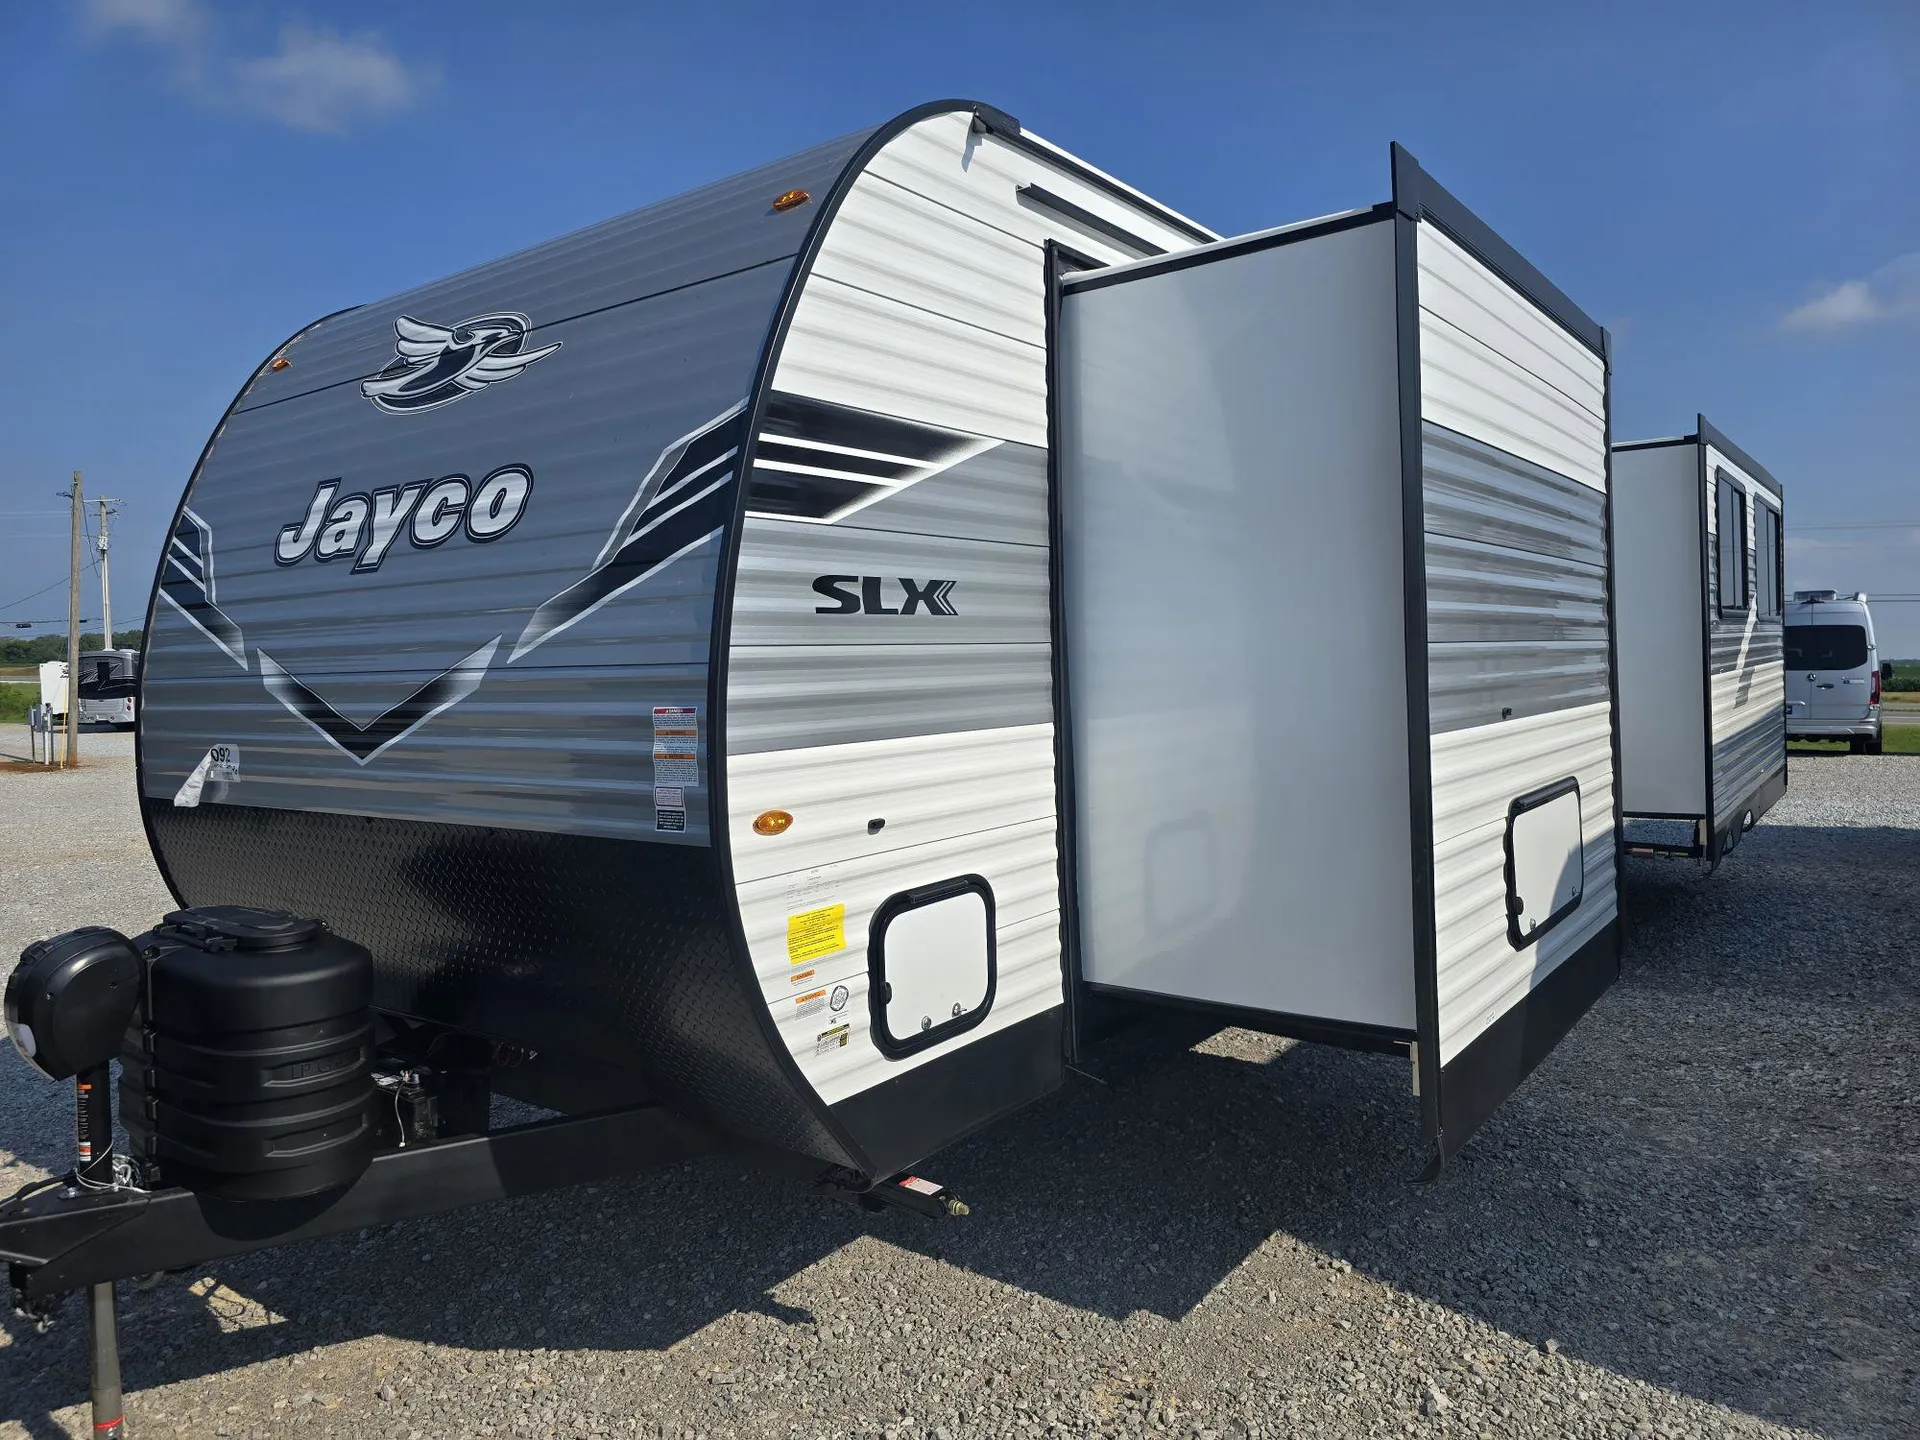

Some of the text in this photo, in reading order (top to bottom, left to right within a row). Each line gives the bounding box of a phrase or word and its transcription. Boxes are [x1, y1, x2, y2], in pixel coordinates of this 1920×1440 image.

[275, 463, 533, 575] Jayco
[812, 574, 958, 615] SLX
[210, 747, 231, 763] 092
